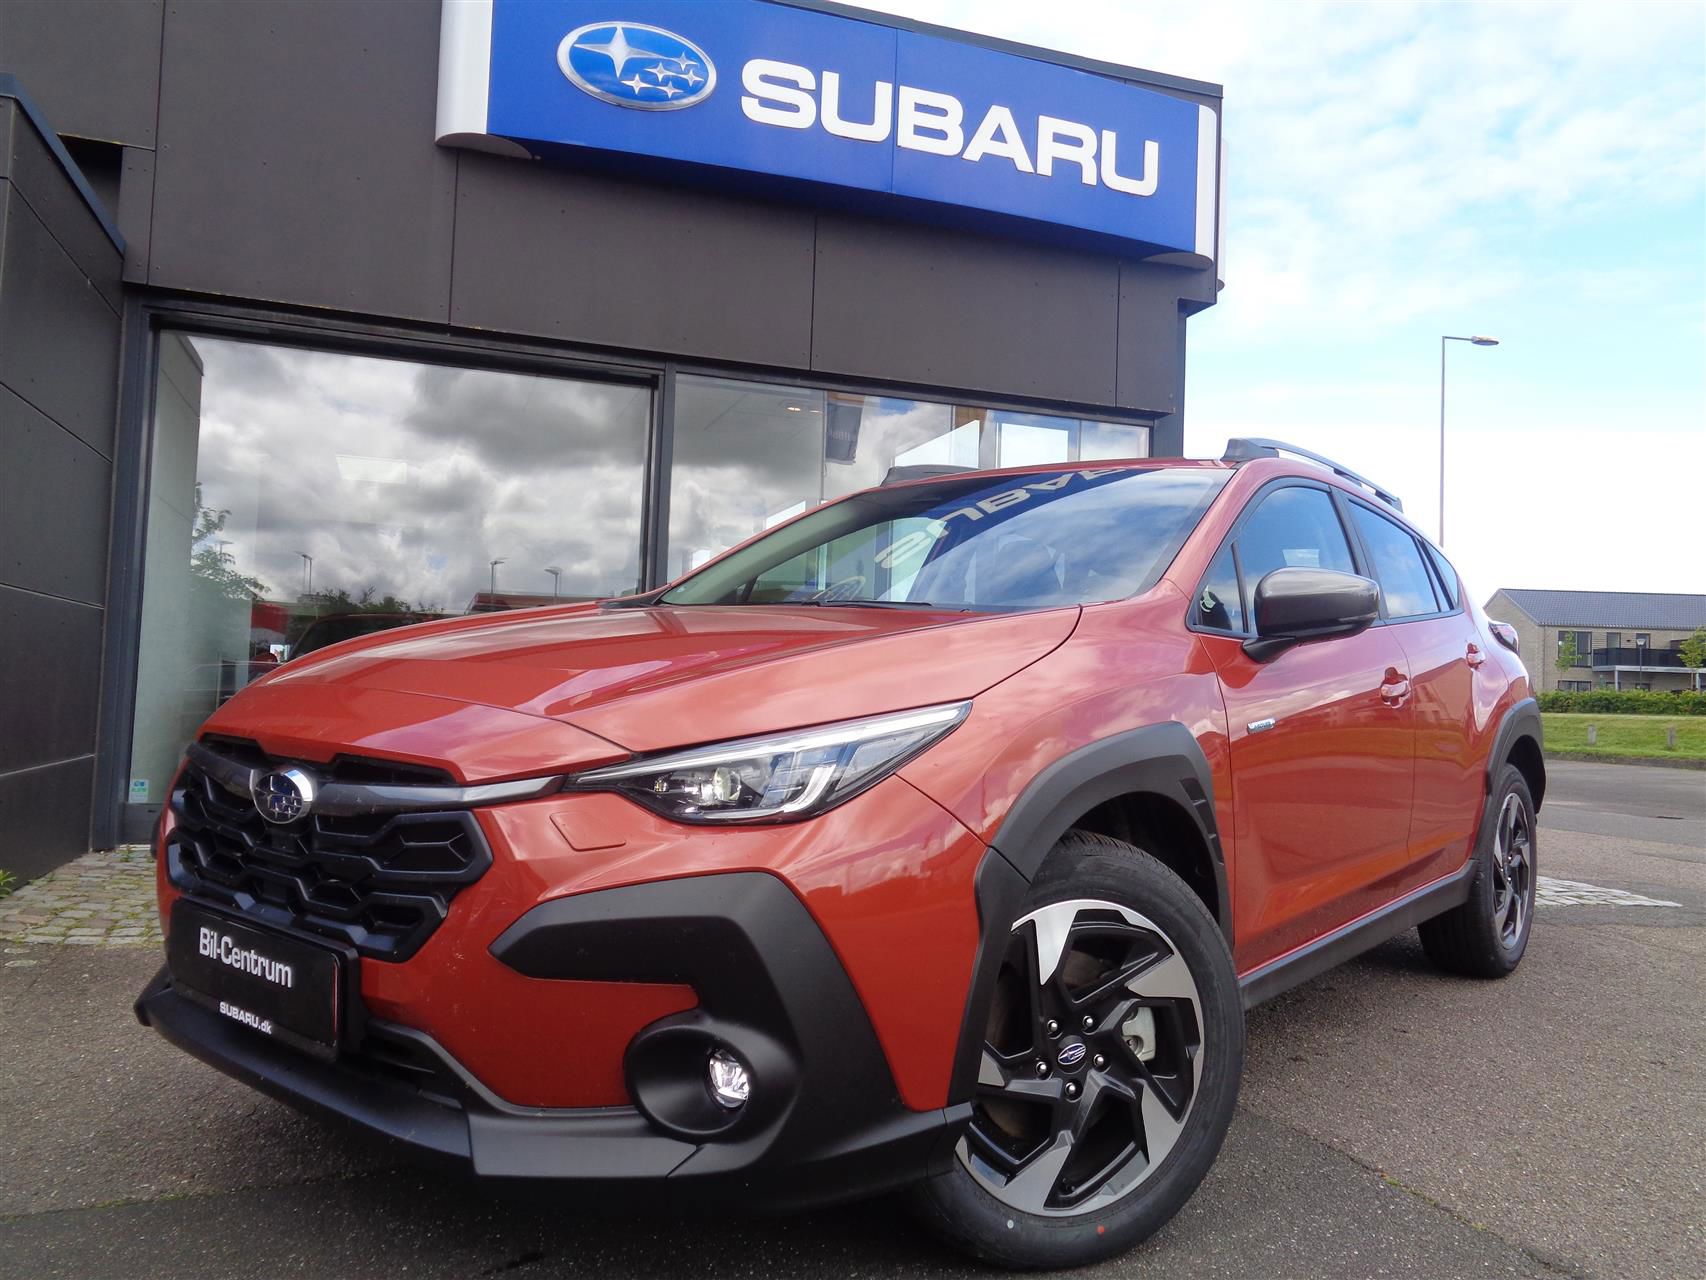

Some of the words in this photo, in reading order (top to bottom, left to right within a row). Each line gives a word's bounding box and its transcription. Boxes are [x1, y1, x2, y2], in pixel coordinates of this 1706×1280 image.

[740, 58, 1159, 197] SUBARU
[199, 926, 293, 989] Bil-Centrum
[219, 1001, 273, 1035] SUBARU.dk
